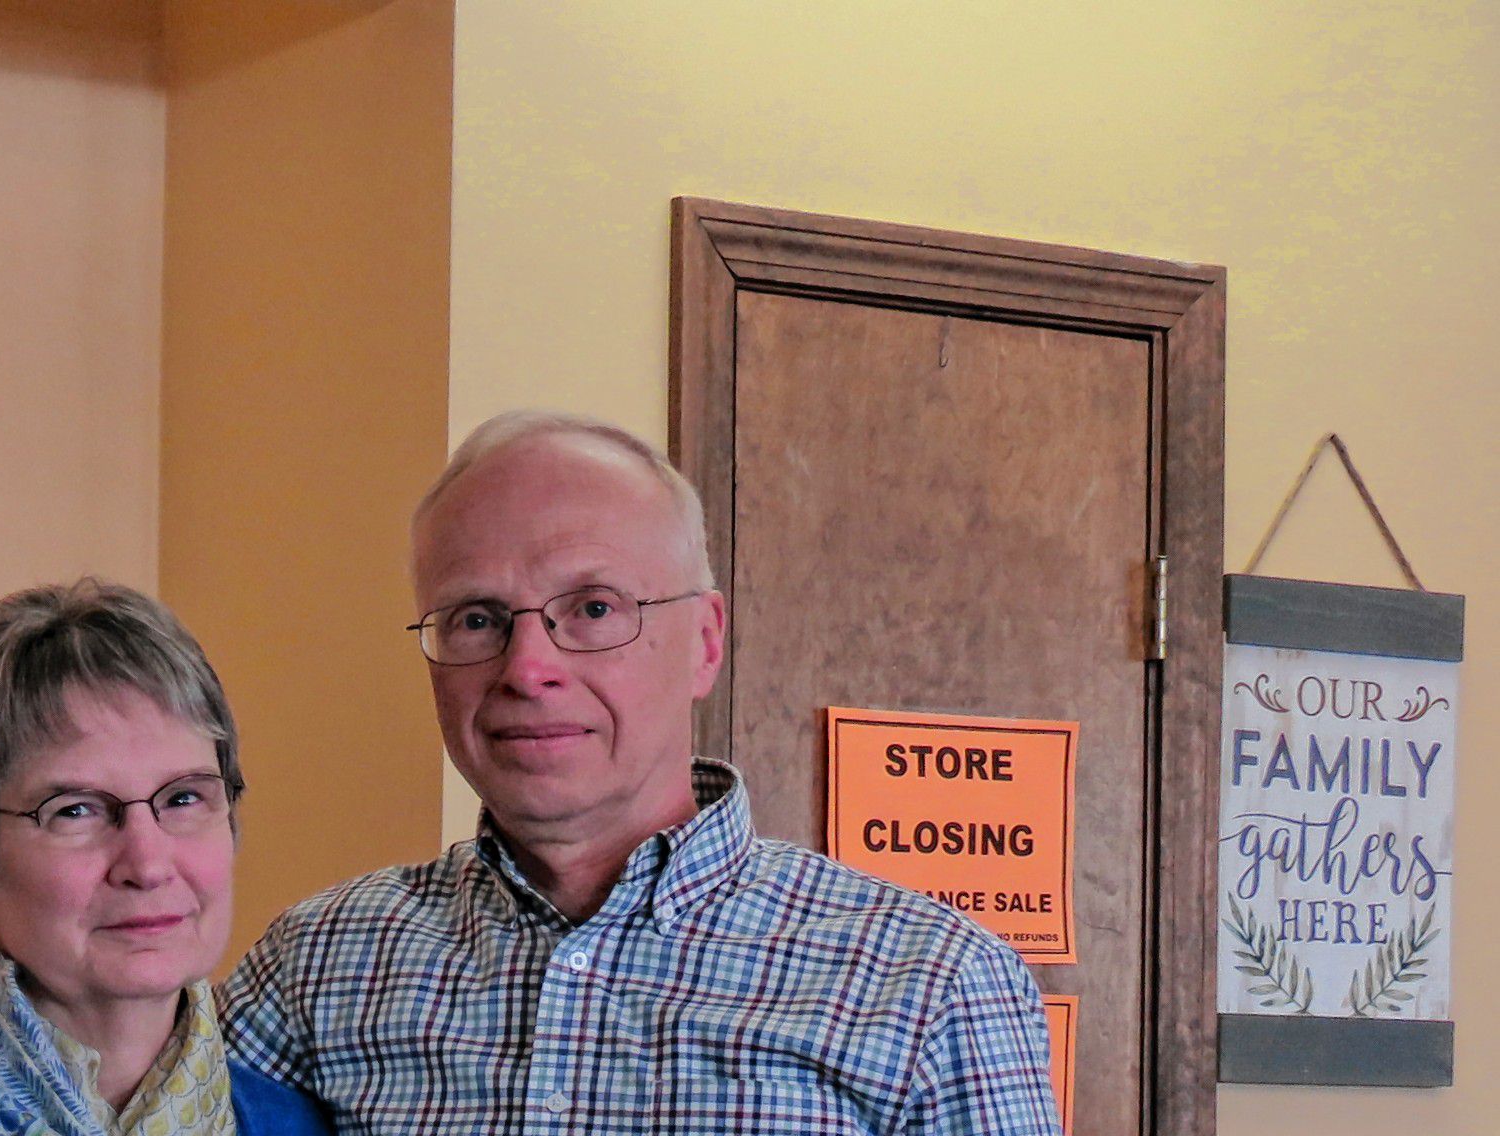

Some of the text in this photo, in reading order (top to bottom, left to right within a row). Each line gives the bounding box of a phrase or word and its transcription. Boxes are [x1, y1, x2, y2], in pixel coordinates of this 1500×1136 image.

[1296, 676, 1388, 722] OUR
[885, 743, 1014, 782] STORE
[1231, 729, 1442, 798] FAMILY
[863, 818, 1035, 857] CLOSING
[1219, 796, 1453, 900] gathers
[993, 893, 1053, 913] SALE
[1276, 899, 1389, 945] HERE
[1013, 932, 1060, 943] REFUNDS
